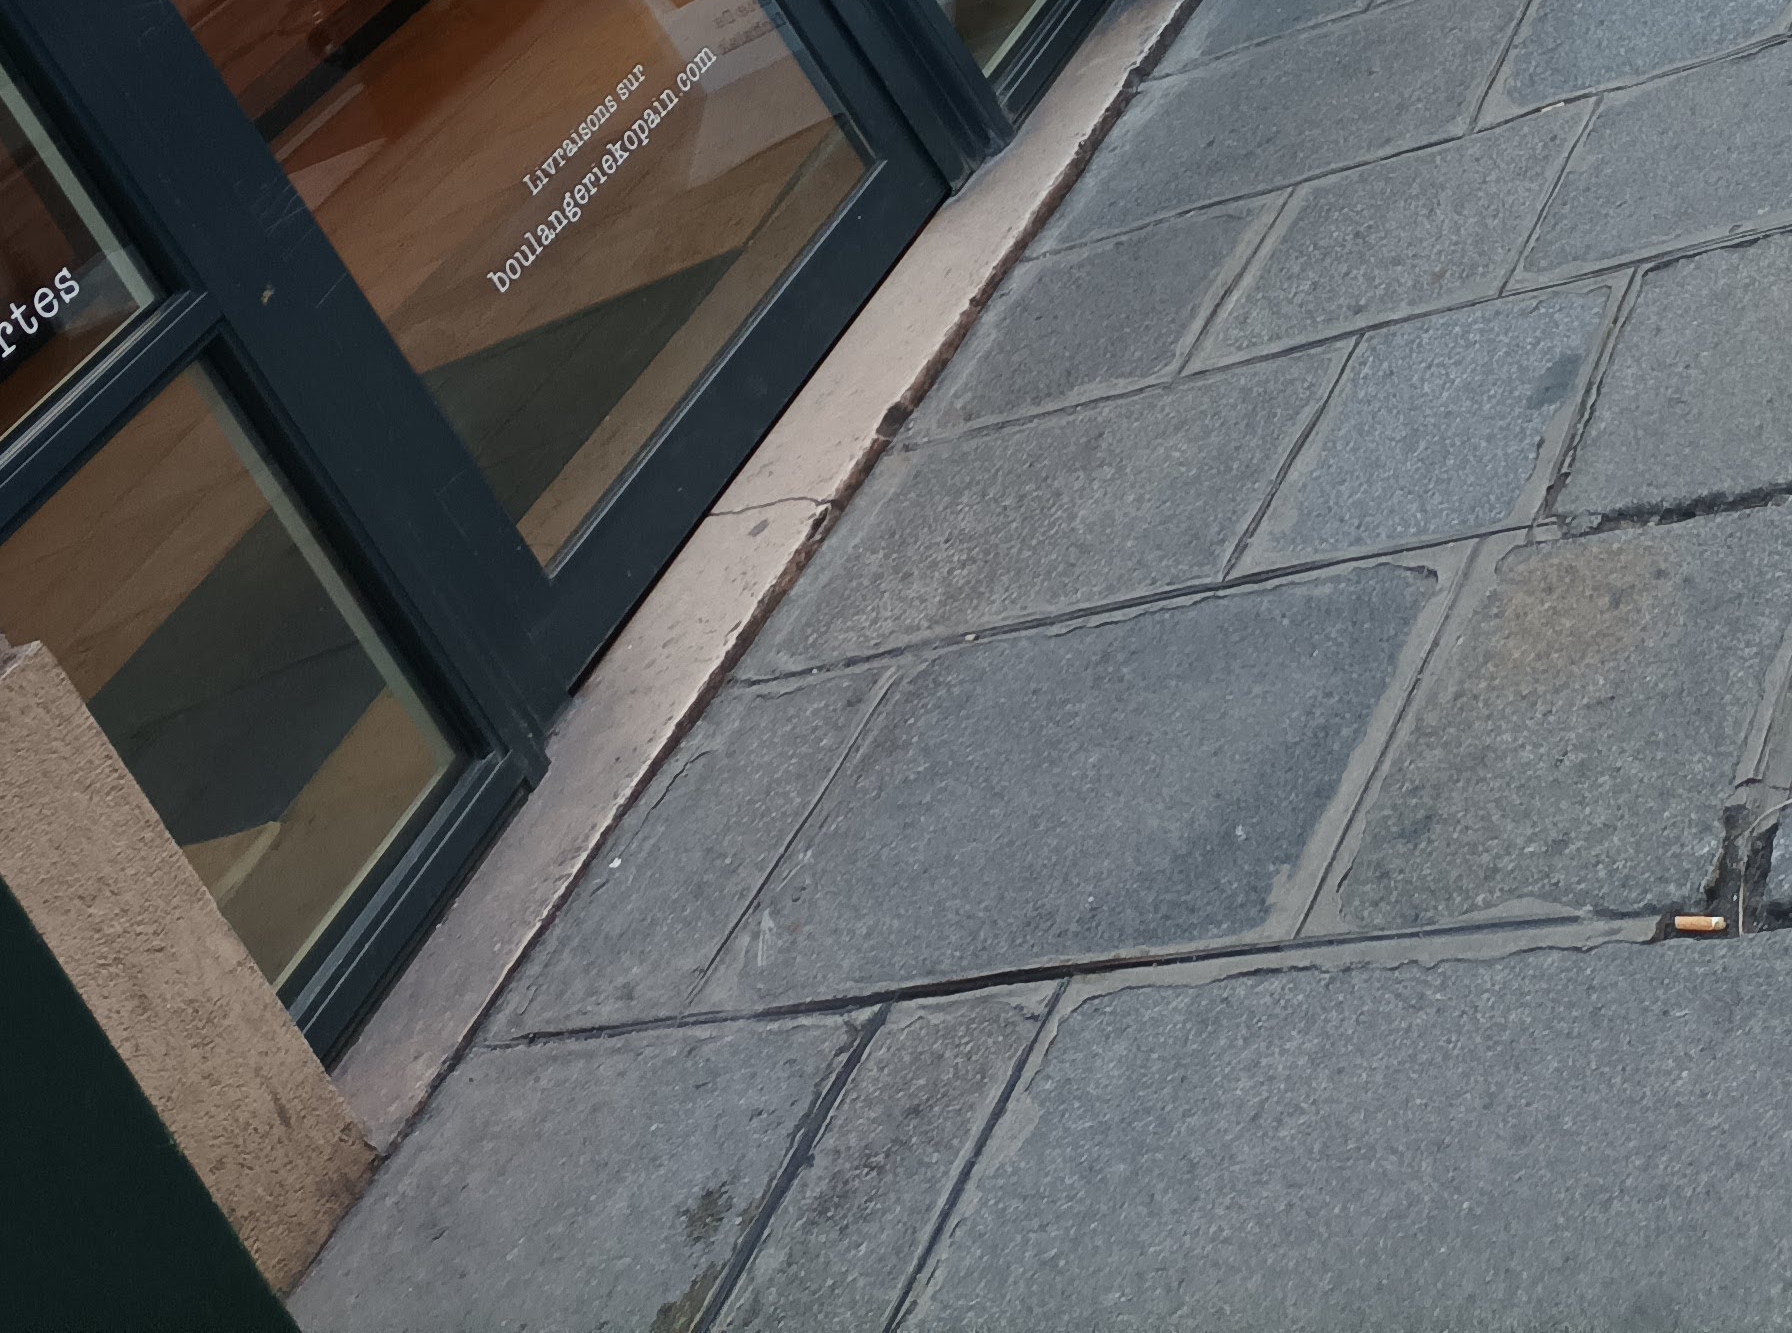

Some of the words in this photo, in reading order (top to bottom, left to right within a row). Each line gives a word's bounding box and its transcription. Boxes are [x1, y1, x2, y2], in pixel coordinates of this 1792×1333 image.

[486, 47, 718, 294] boulangeriekopain.com
[522, 94, 618, 196] Livraisons
[616, 64, 646, 101] sur
